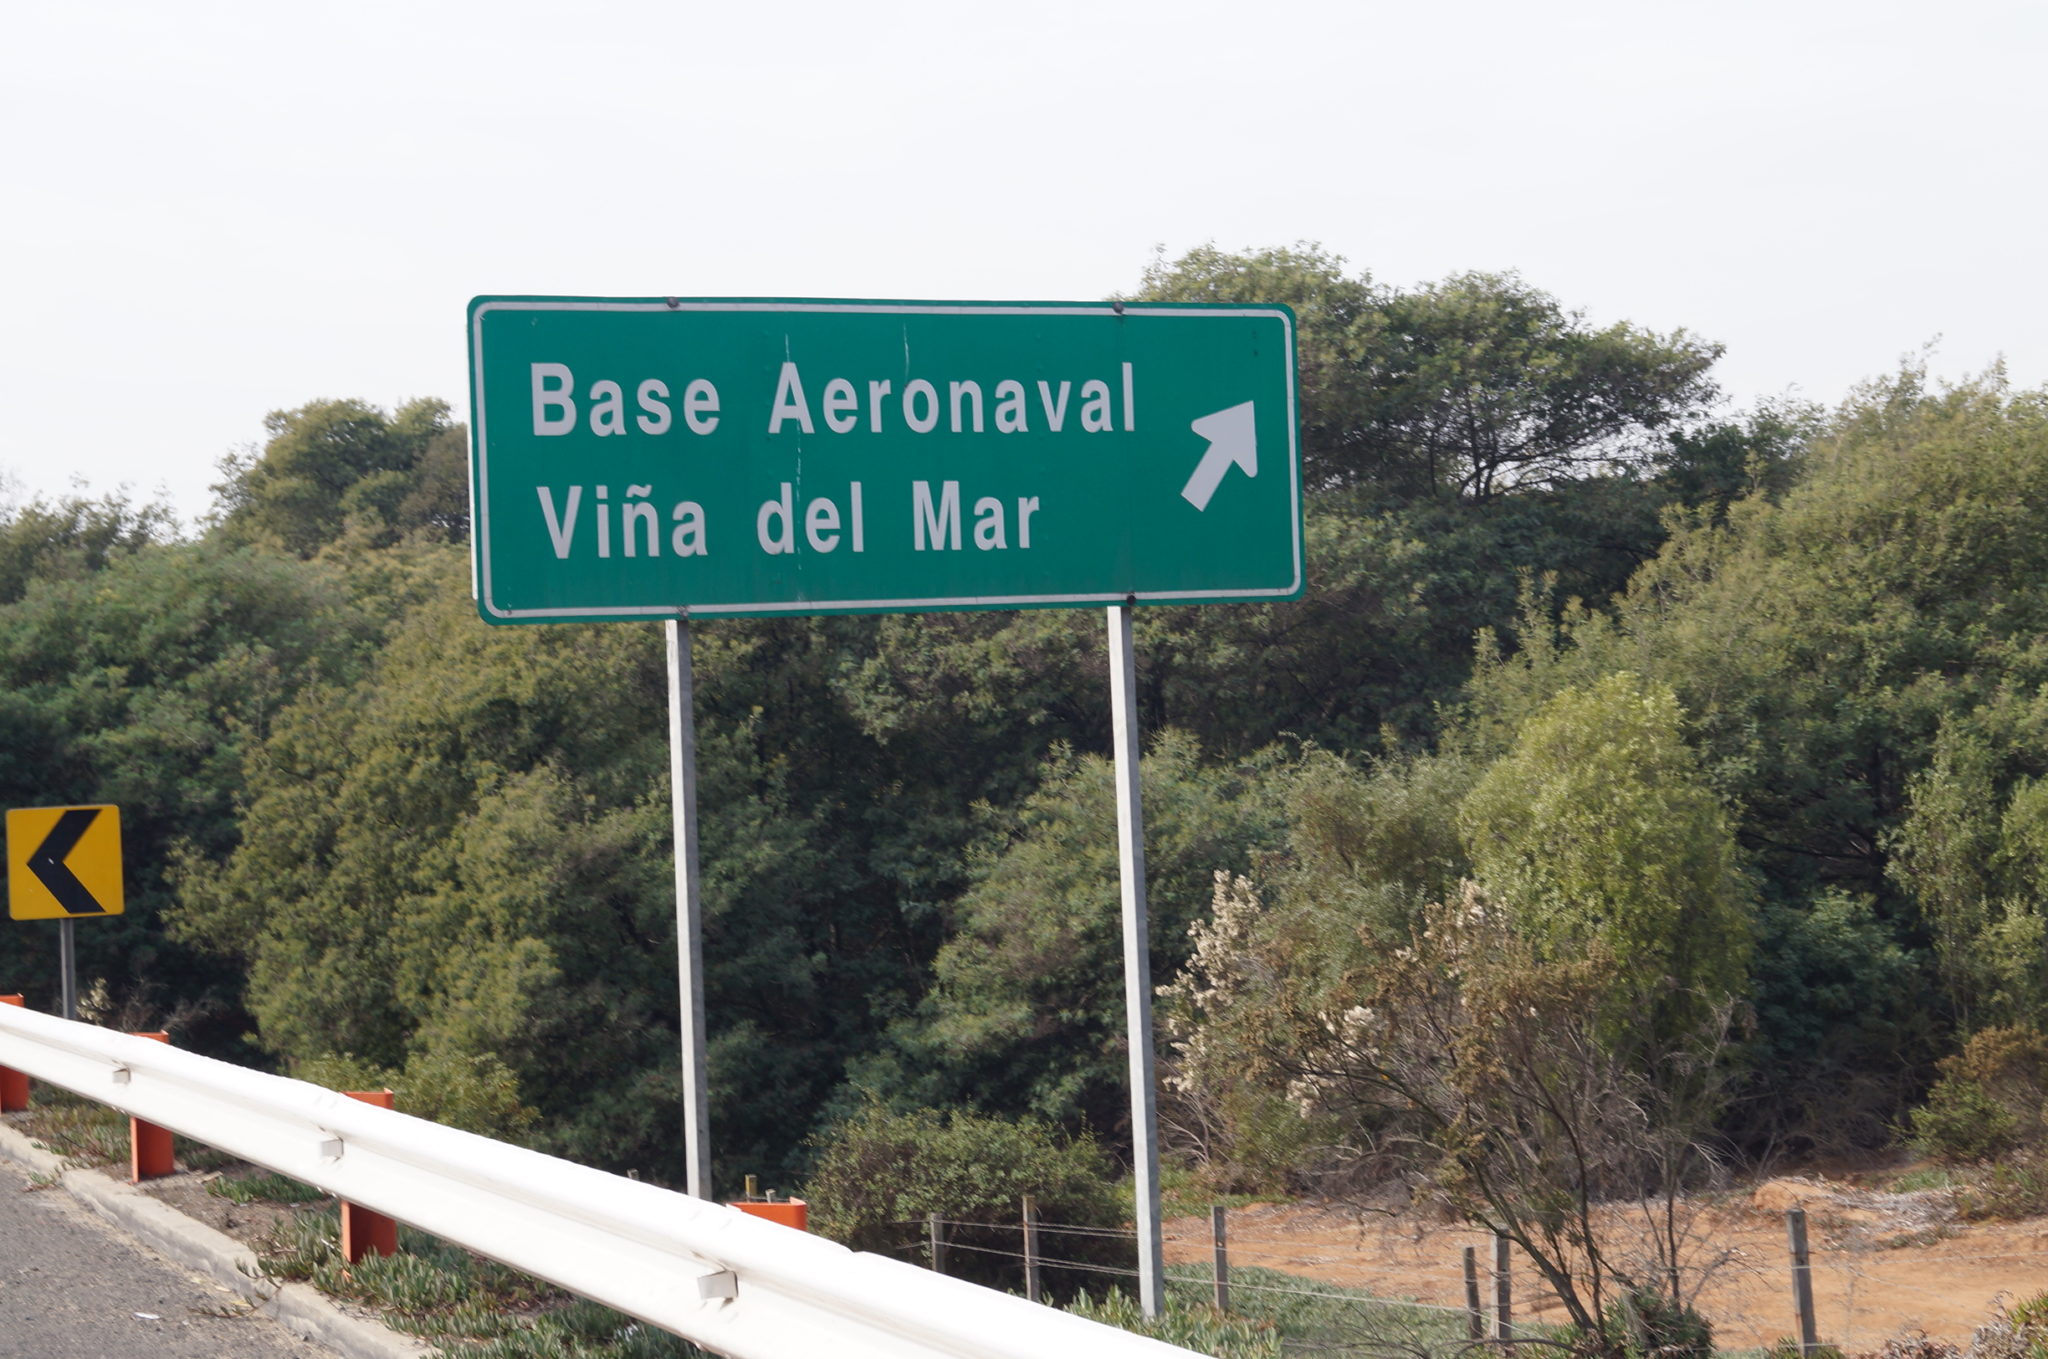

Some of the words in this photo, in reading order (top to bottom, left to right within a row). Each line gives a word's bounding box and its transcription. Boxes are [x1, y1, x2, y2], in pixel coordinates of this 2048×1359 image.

[531, 362, 721, 437] Base
[768, 361, 1135, 436] Aeronaval
[536, 483, 709, 560] Viña
[756, 480, 865, 556] del
[912, 479, 1040, 553] Mar
